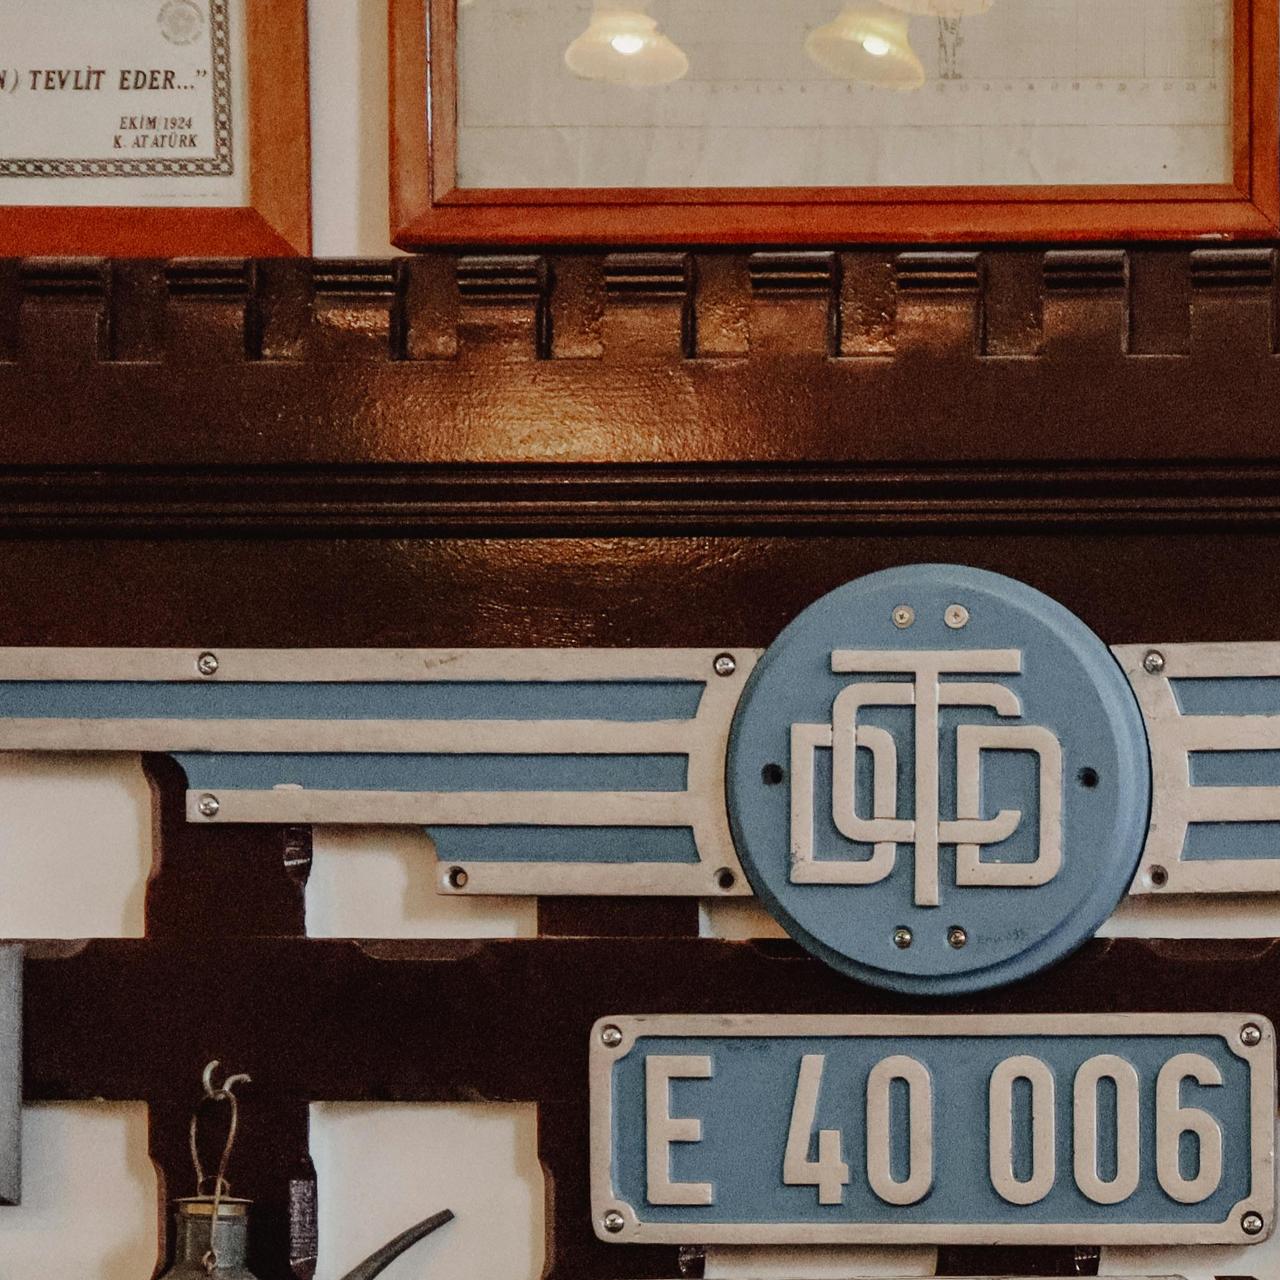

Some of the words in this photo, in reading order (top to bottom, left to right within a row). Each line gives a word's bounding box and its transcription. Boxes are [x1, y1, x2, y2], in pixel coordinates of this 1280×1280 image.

[29, 65, 106, 90] TEVLİT
[119, 114, 157, 130] EKİM
[163, 116, 193, 130] 1924
[132, 133, 198, 148] ATATÜRK
[645, 1054, 713, 1206] E
[782, 1054, 933, 1206] 40
[990, 1053, 1223, 1205] 006
